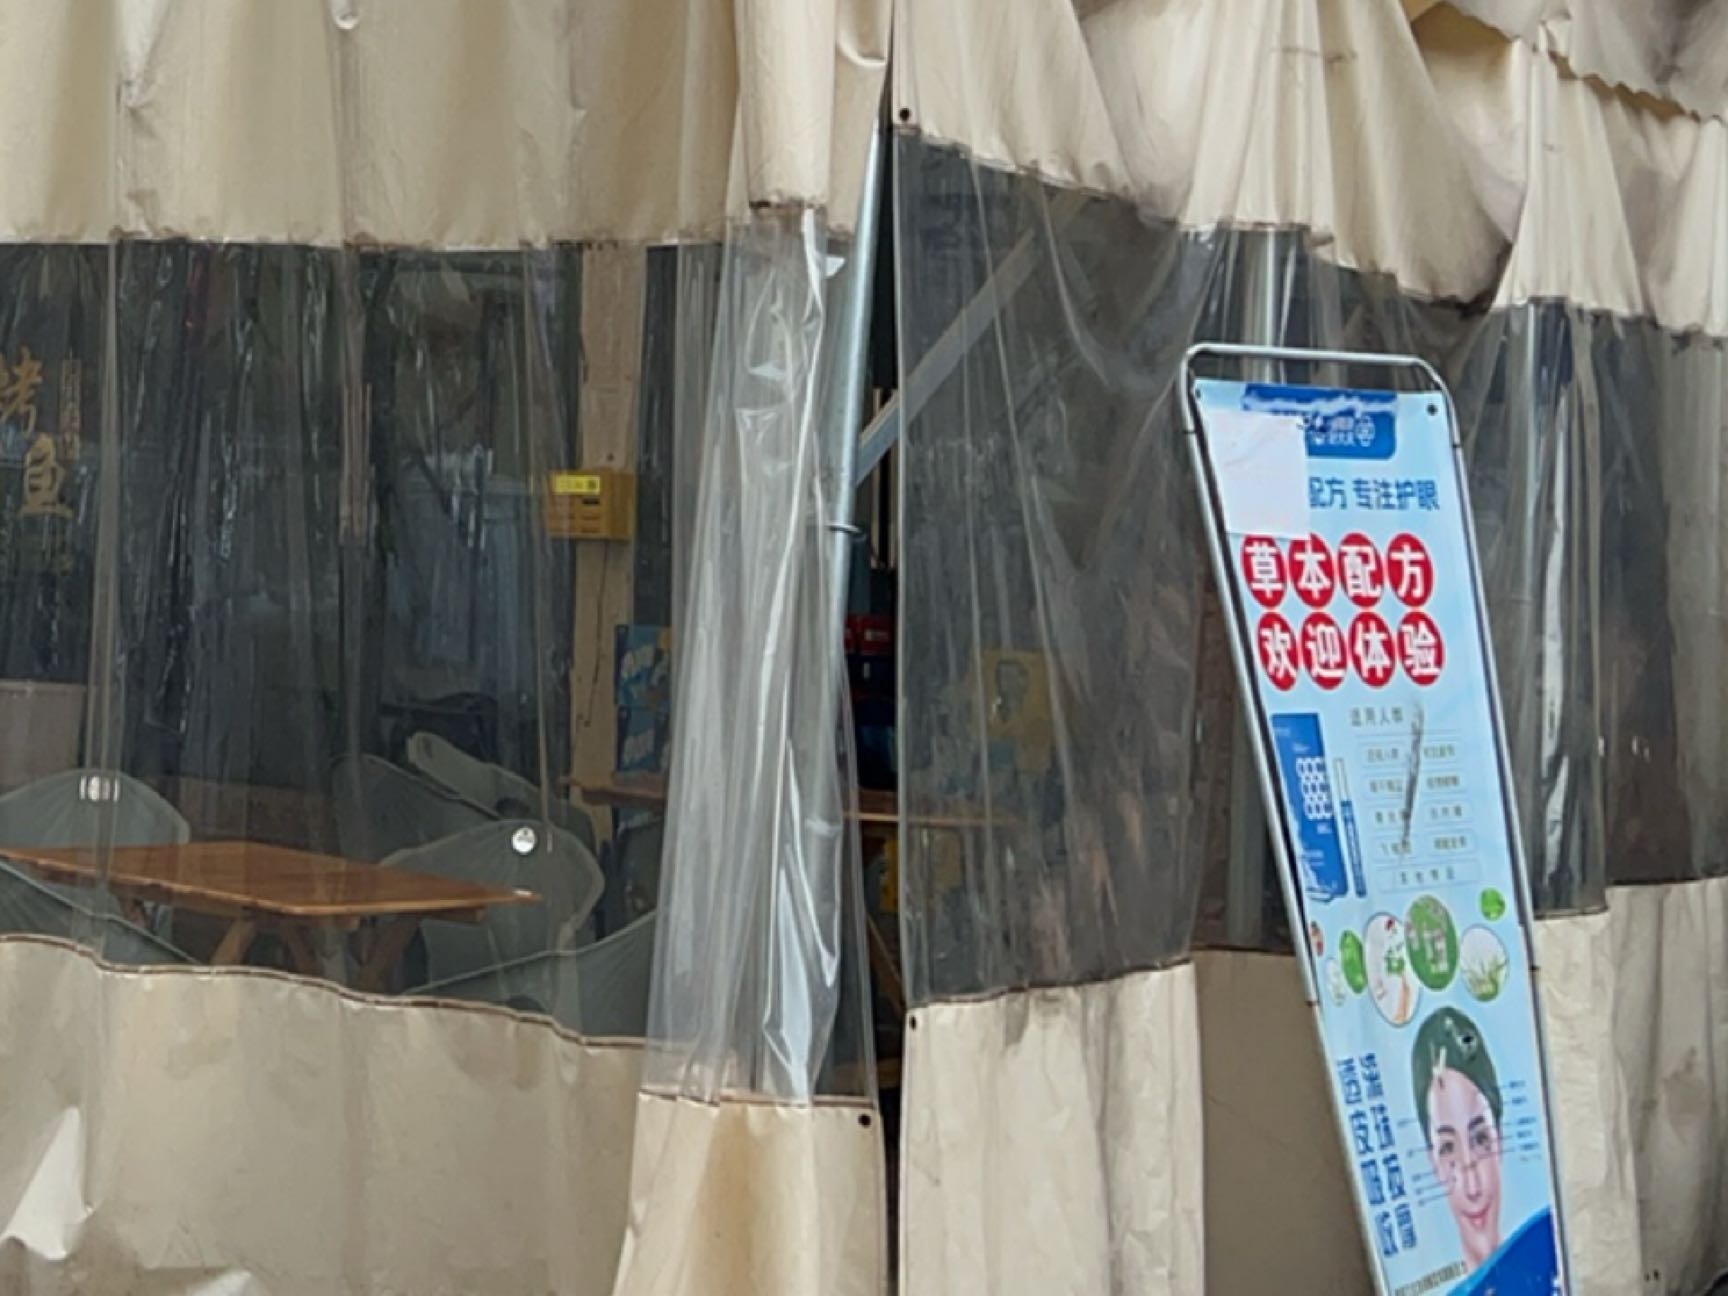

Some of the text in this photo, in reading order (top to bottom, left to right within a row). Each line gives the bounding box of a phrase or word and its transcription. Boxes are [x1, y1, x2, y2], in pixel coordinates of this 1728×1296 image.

[1243, 541, 1430, 602] 草本配方
[1259, 621, 1445, 680] 欢迎体验
